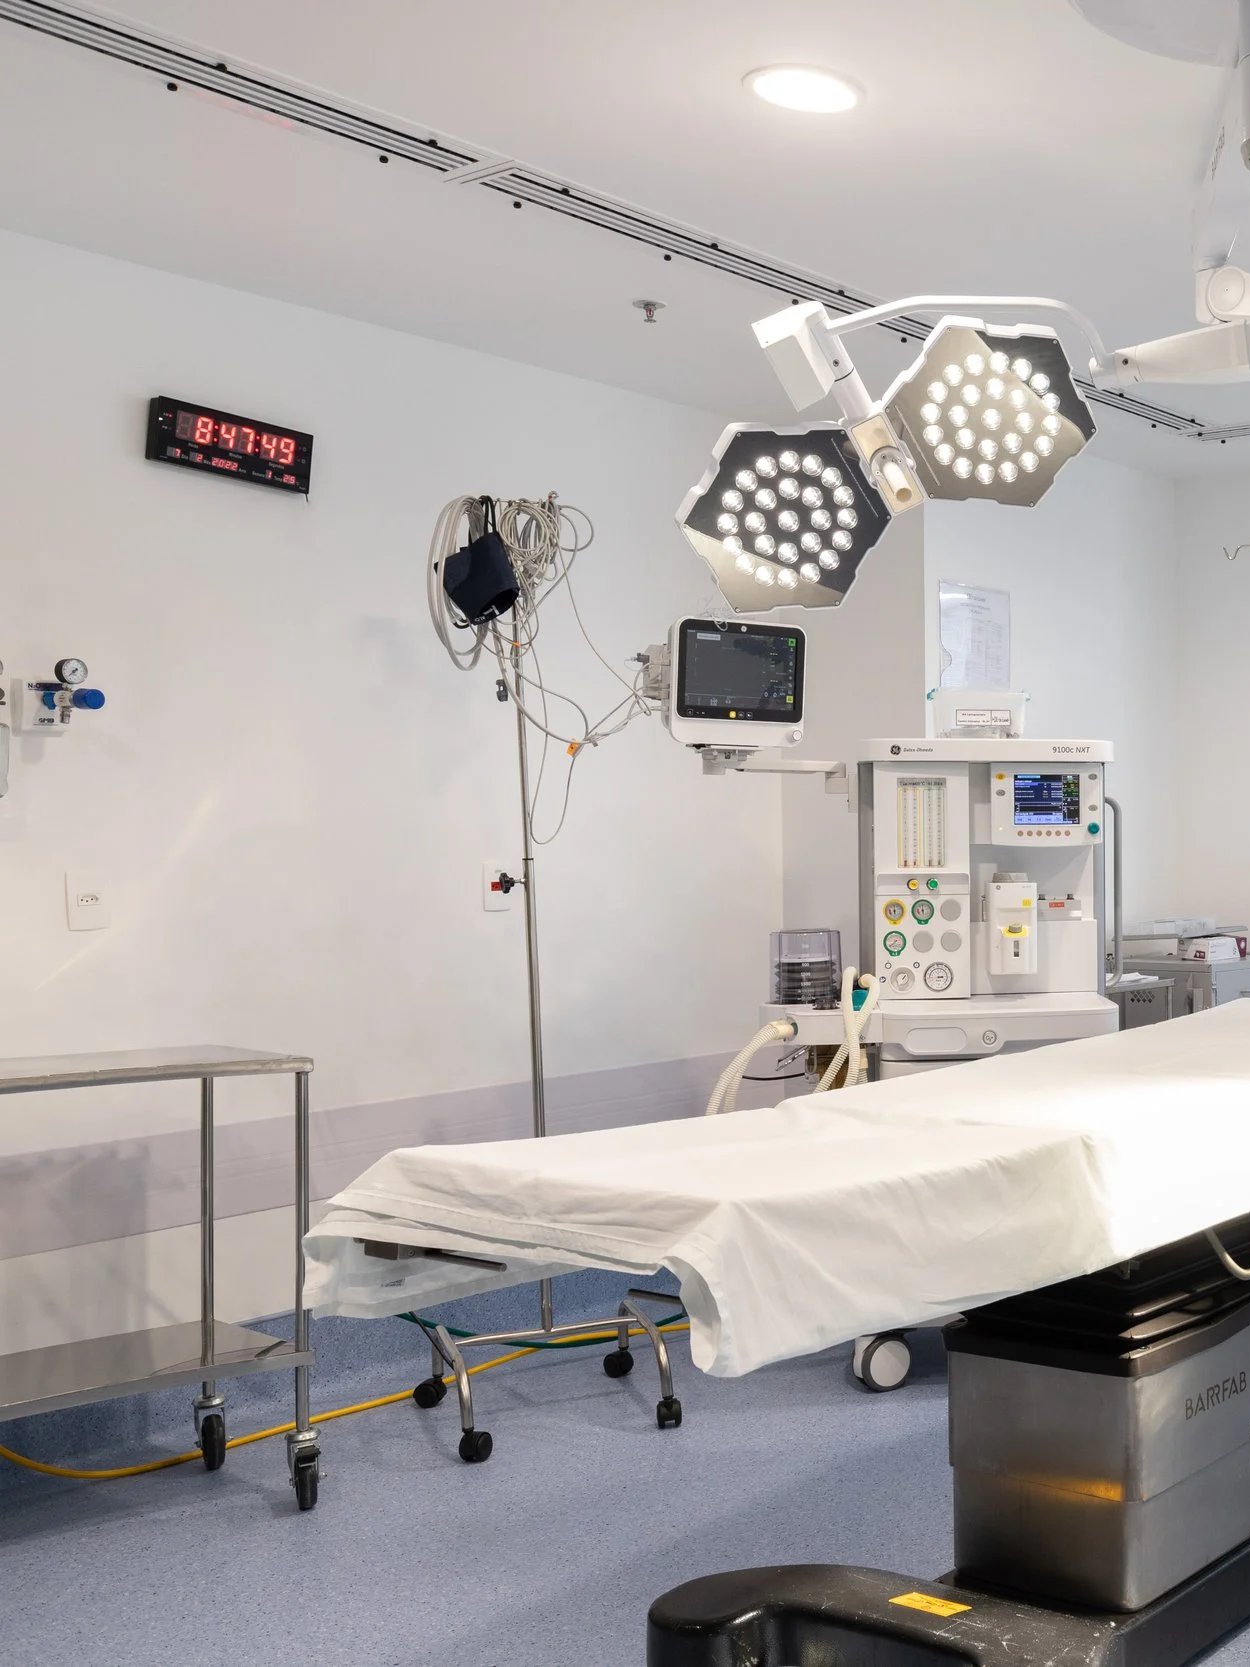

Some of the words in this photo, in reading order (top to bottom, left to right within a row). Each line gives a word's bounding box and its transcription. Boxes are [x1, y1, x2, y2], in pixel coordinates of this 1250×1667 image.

[194, 416, 296, 464] 8:47:49
[211, 457, 238, 471] 2022
[1052, 746, 1074, 754] 9100c
[1185, 1371, 1247, 1420] BARRFAB
